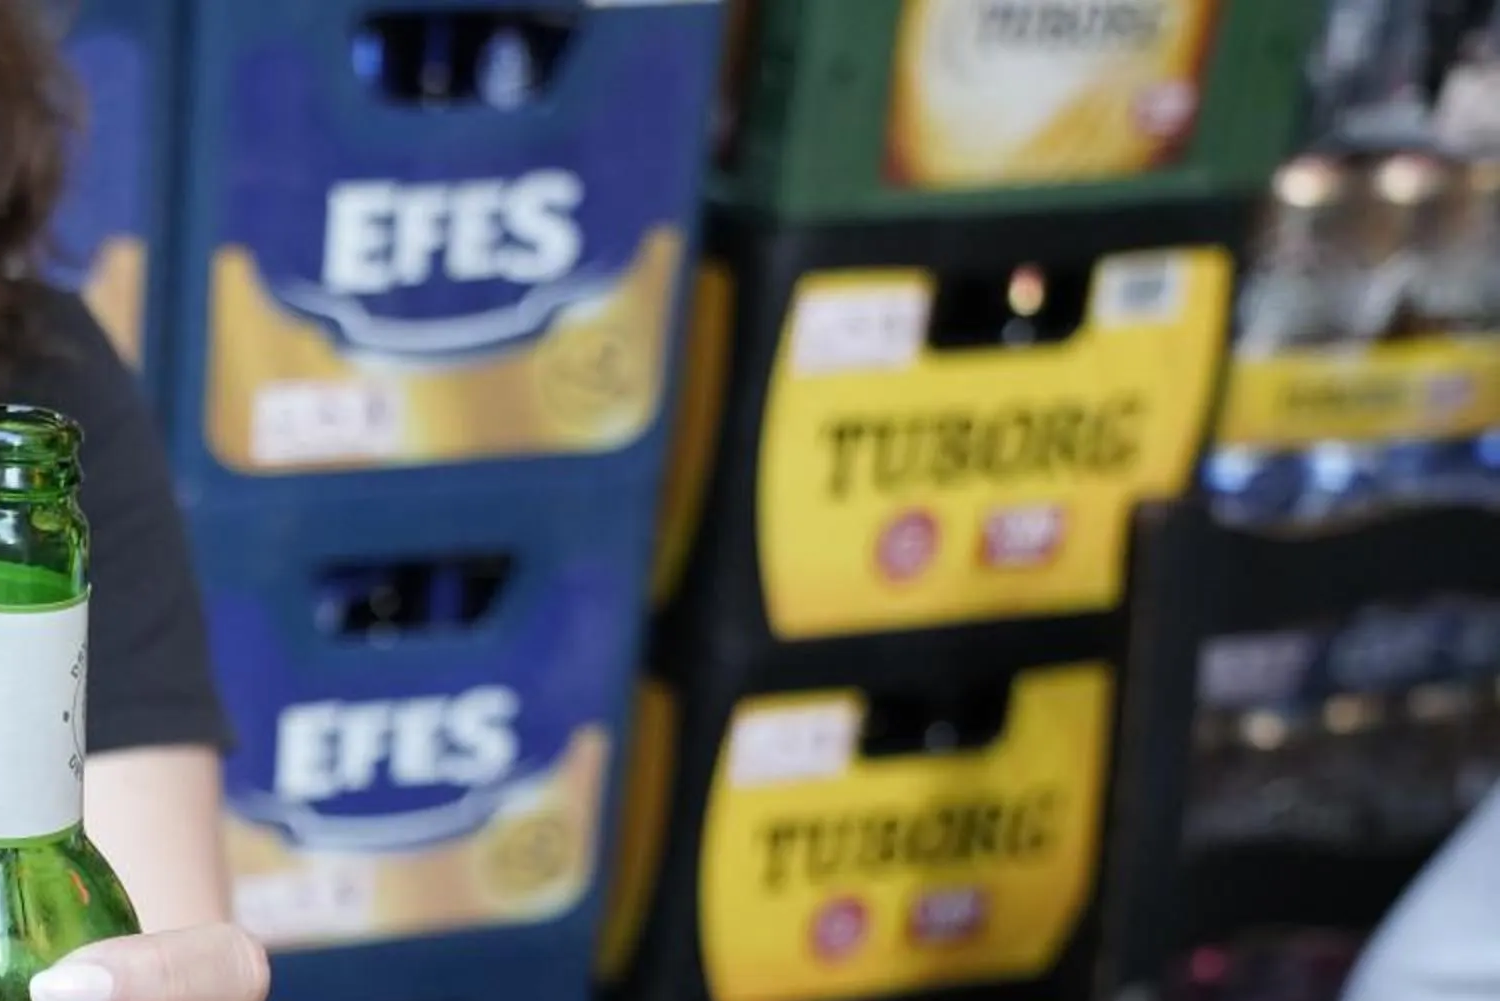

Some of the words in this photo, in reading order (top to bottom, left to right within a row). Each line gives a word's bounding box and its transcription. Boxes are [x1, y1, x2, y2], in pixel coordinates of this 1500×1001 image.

[322, 166, 584, 294] EFES
[818, 392, 1145, 502] TUBORG
[273, 684, 520, 800] EFES
[756, 784, 1056, 893] TUBORG
